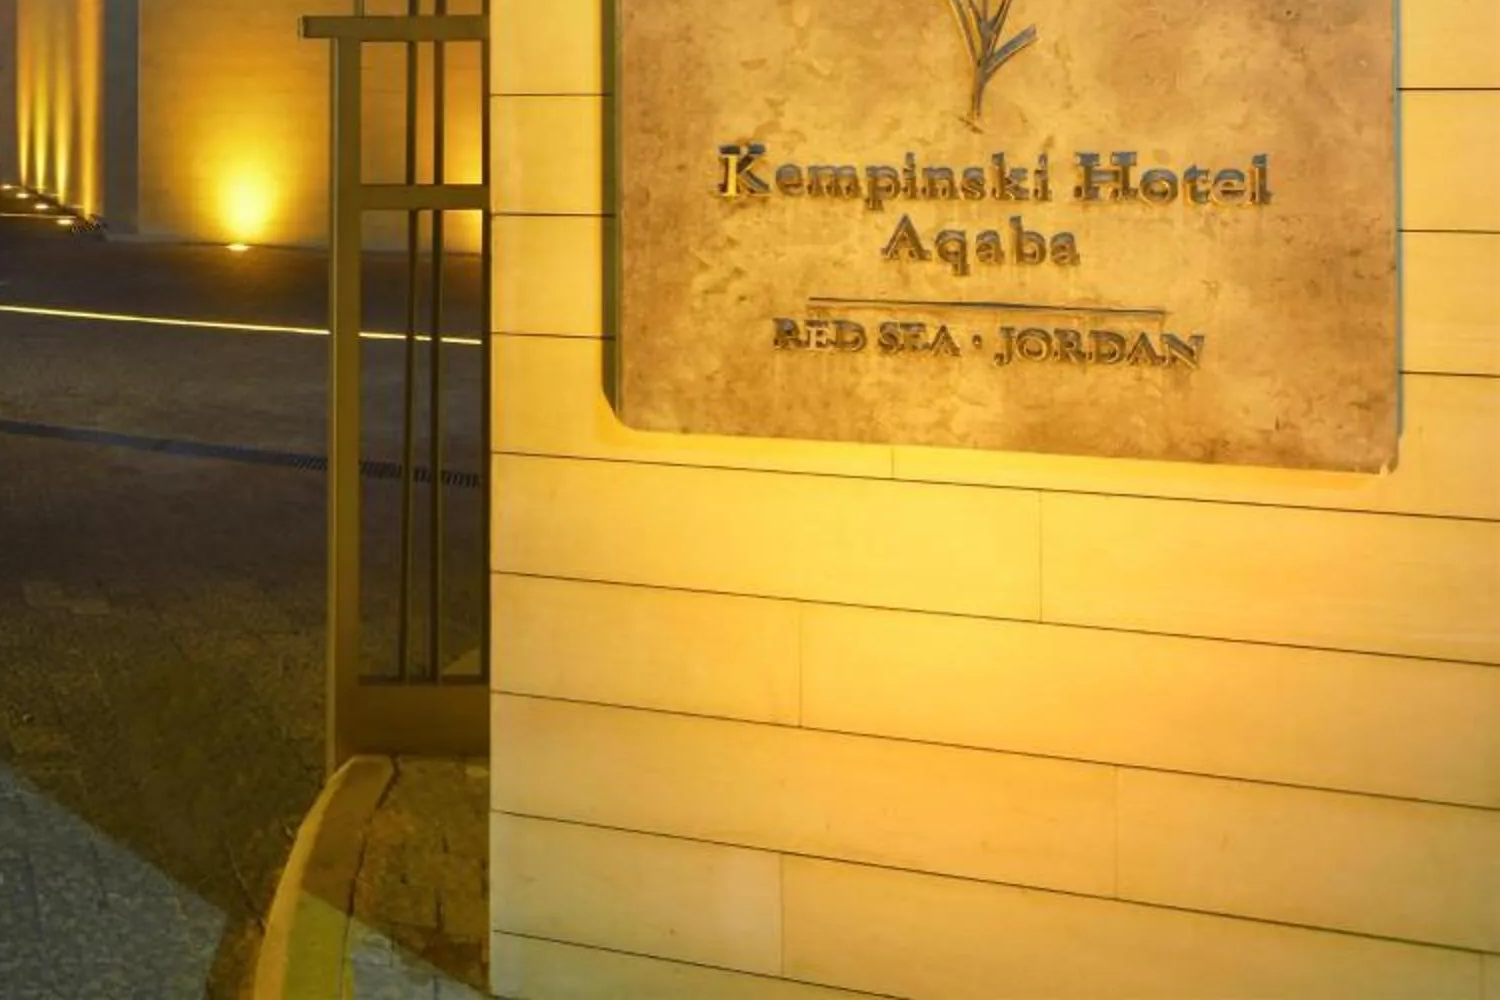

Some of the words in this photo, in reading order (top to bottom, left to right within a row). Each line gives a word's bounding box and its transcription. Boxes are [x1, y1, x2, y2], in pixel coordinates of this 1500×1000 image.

[718, 144, 1052, 211] Kempinski
[1073, 150, 1273, 206] Hotel
[880, 213, 1081, 276] Aqaba
[772, 317, 867, 352] RED
[877, 320, 961, 356] SEA
[993, 326, 1205, 370] JORDAN
